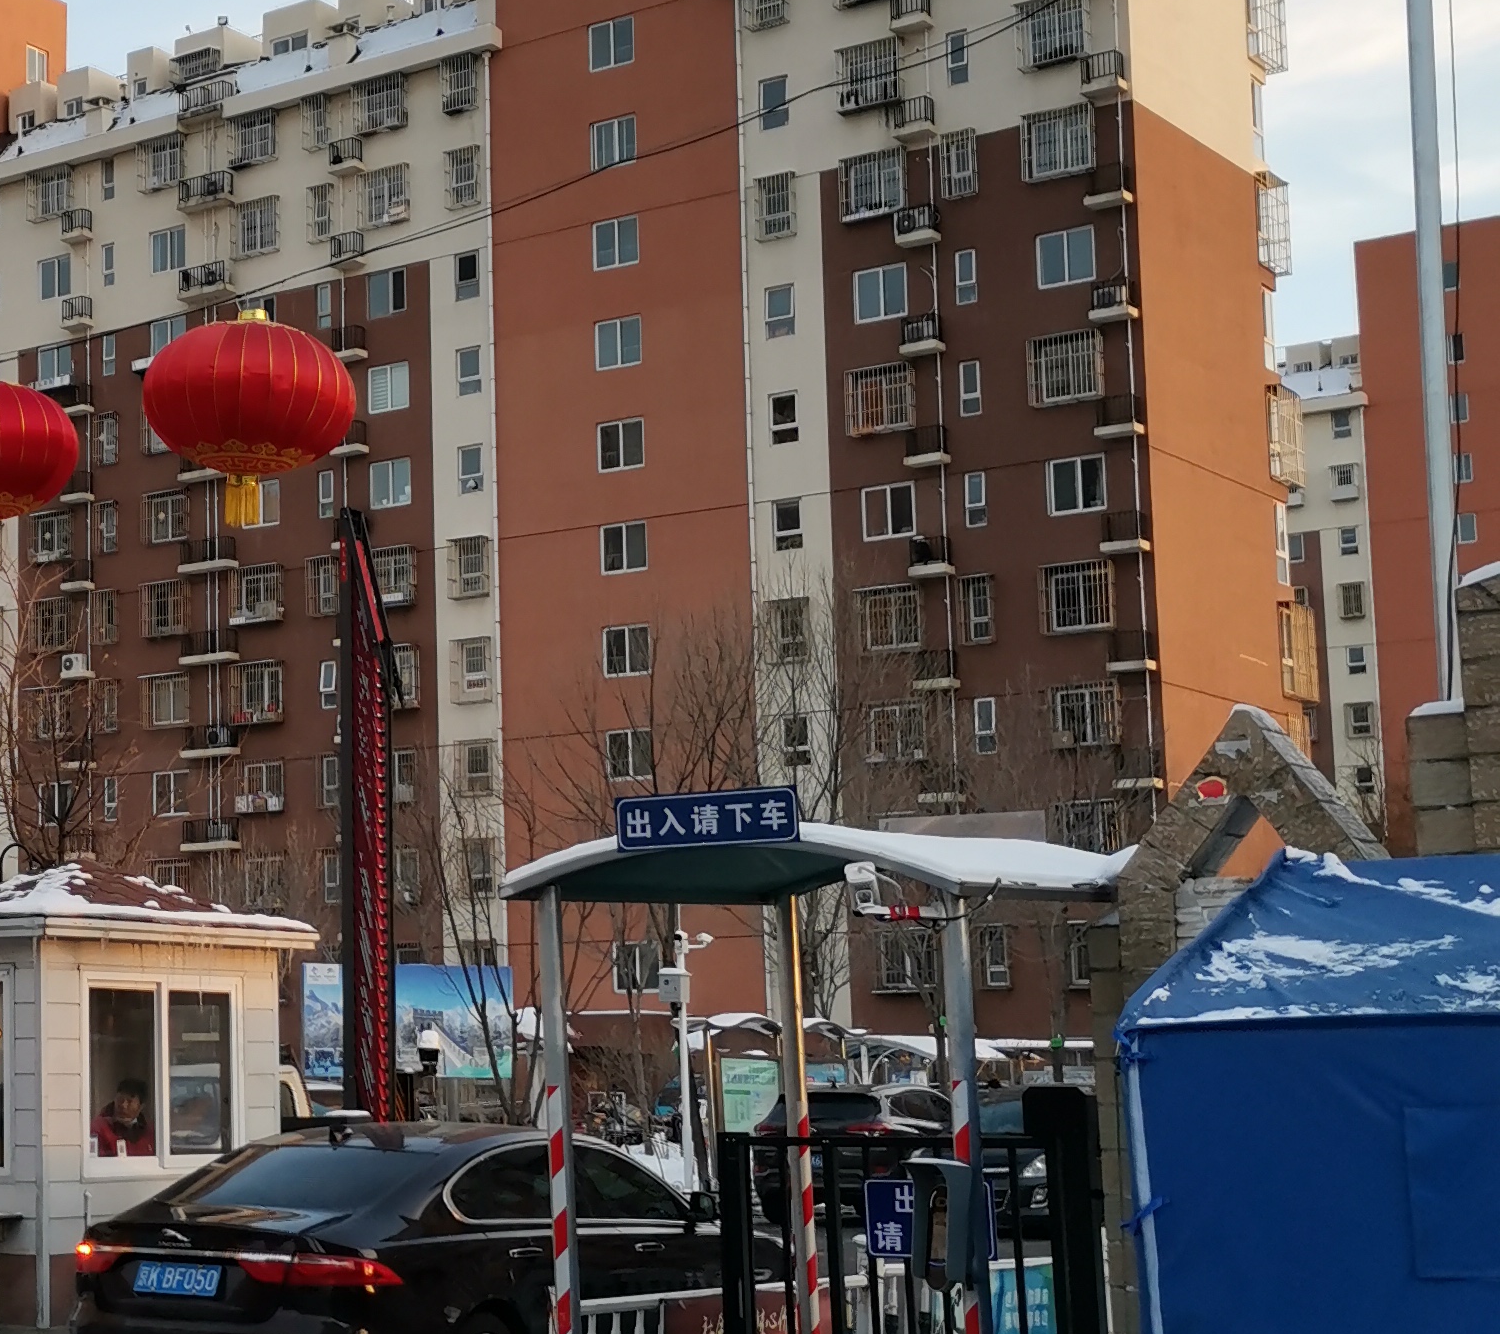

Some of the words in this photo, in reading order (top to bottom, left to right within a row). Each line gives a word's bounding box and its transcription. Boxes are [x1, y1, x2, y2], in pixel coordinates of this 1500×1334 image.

[626, 799, 788, 838] 出入请下车
